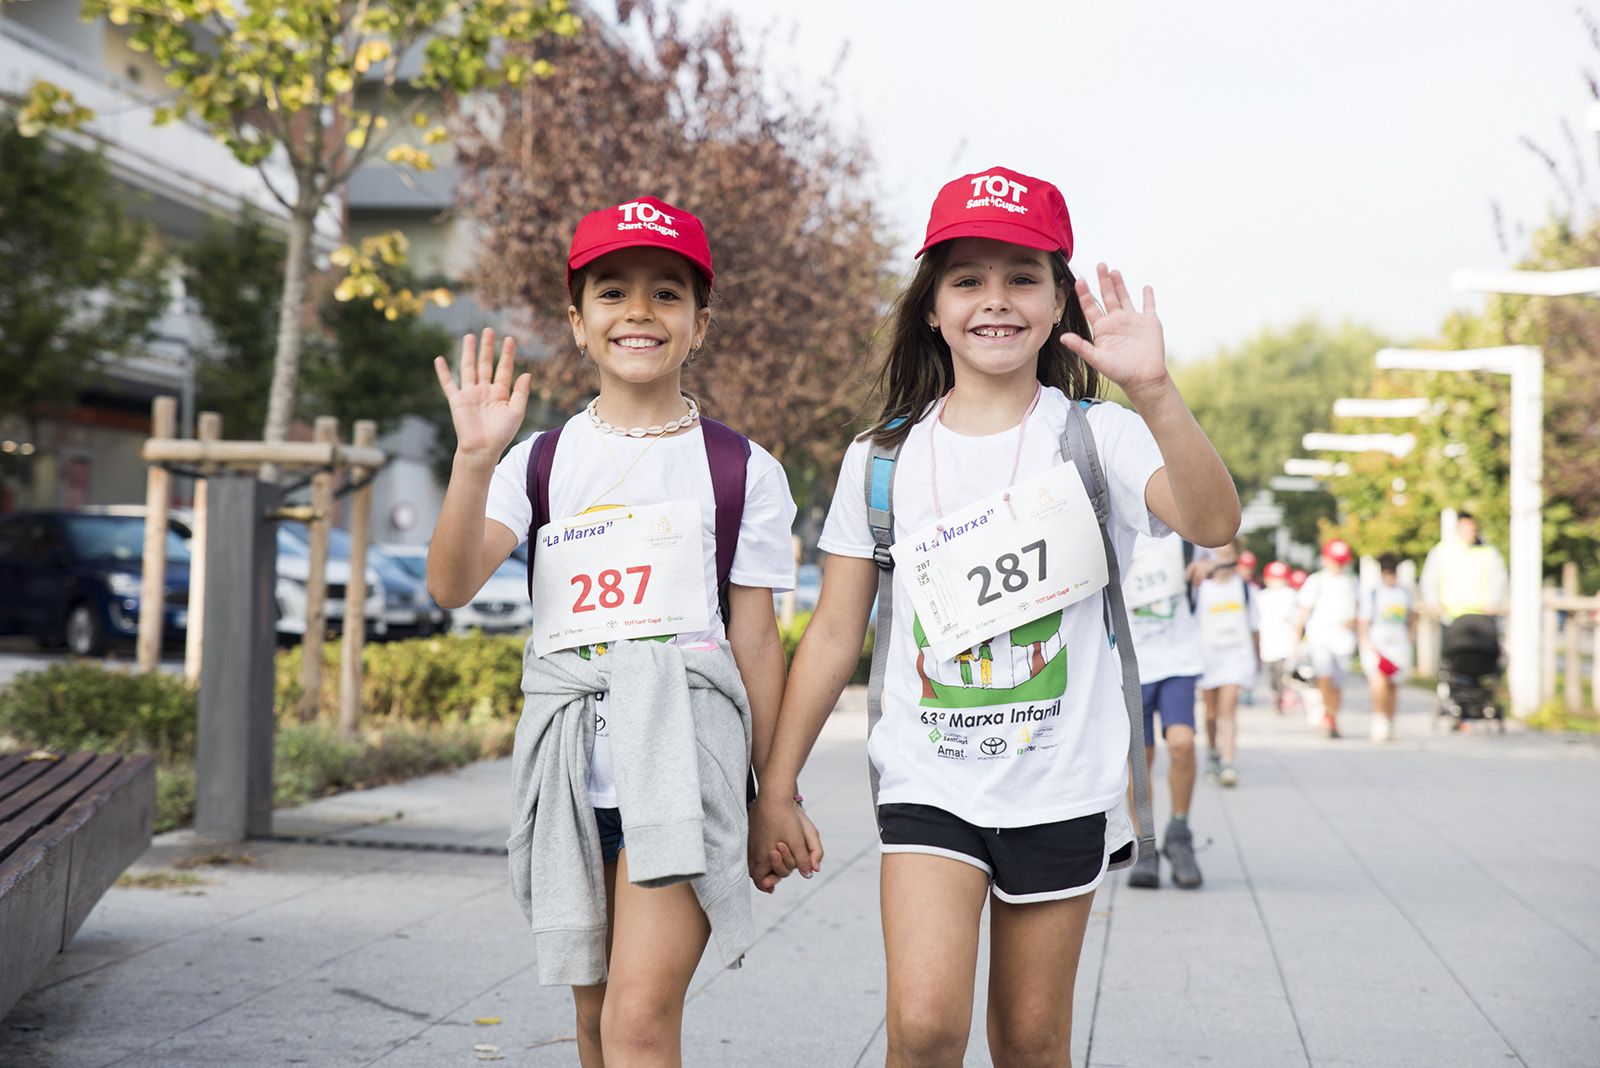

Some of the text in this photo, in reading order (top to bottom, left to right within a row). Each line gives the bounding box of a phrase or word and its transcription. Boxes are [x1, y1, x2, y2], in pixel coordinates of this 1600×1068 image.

[969, 174, 1028, 203] TOT
[965, 196, 990, 209] Sant
[618, 201, 676, 226] TOT
[617, 221, 643, 231] Sant
[915, 559, 931, 572] 287
[966, 538, 1047, 607] 287
[570, 564, 652, 614] 287
[949, 712, 1005, 728] Marxa
